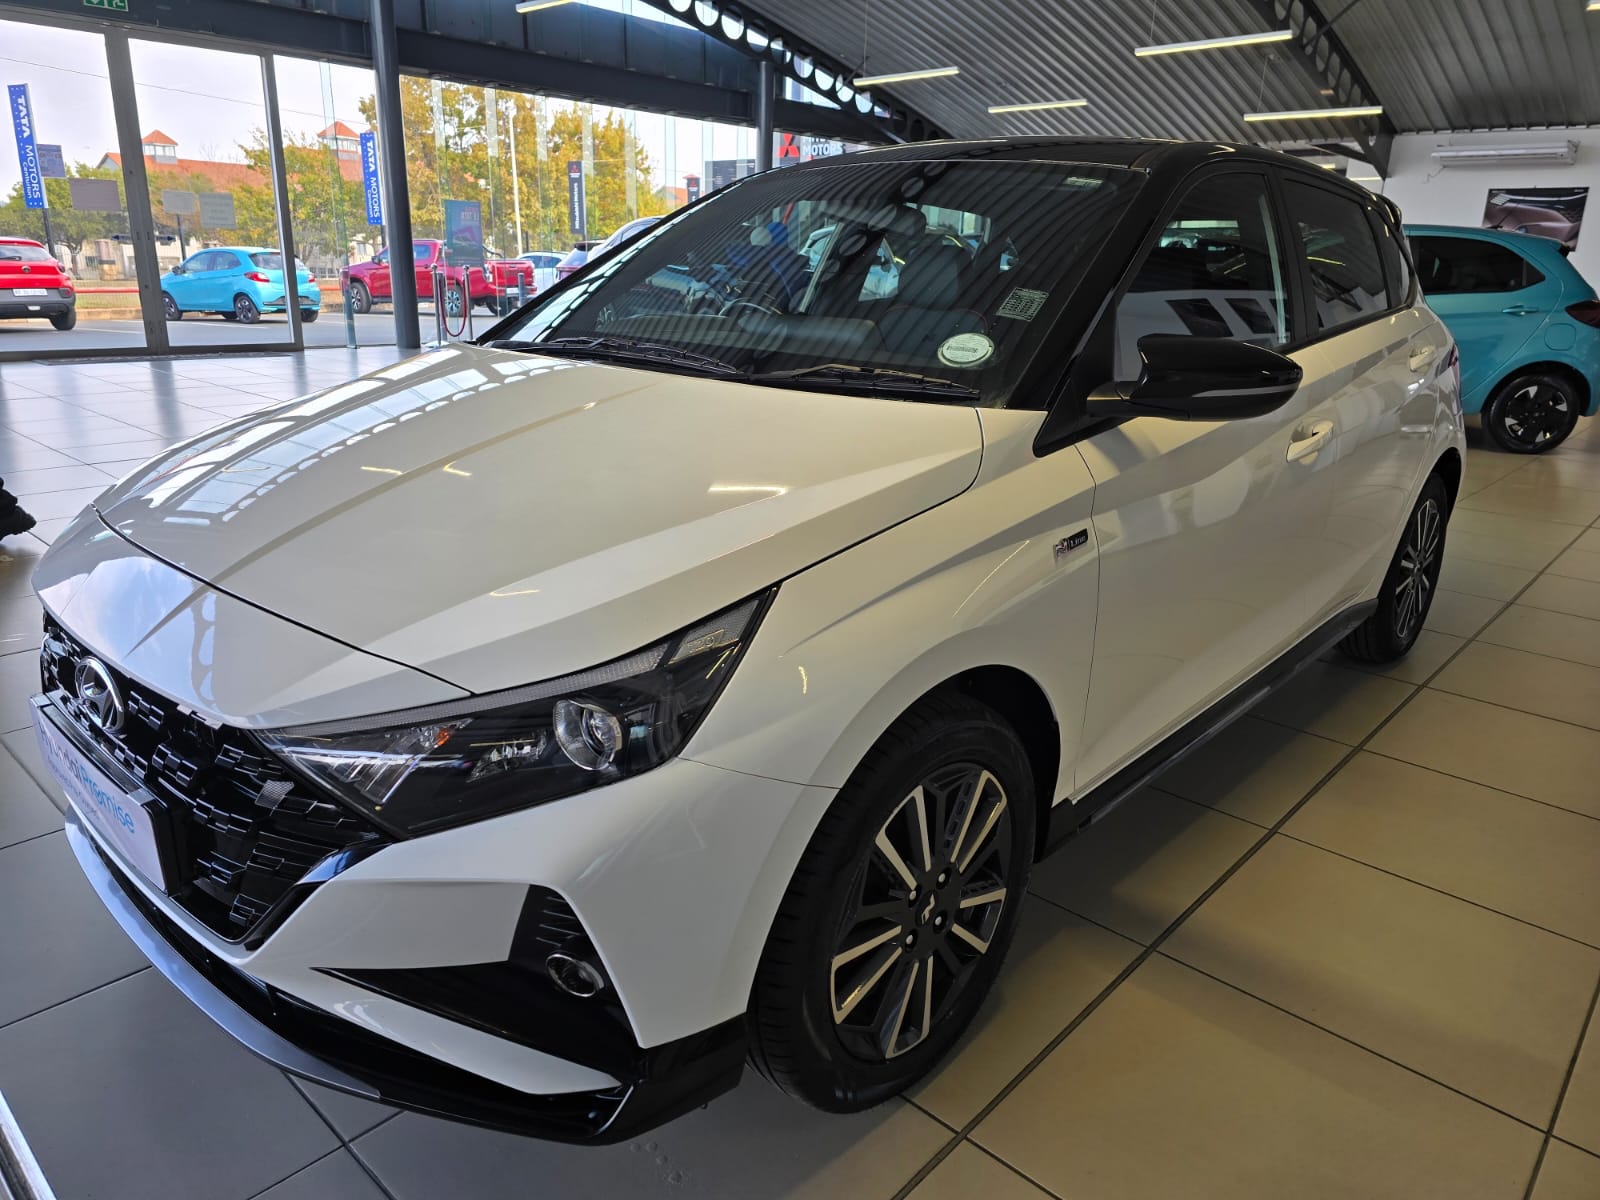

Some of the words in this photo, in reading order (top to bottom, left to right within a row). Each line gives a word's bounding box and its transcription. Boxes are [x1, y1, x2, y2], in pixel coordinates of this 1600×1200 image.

[17, 95, 30, 138] TATA
[25, 145, 41, 199] MOTORS
[366, 140, 376, 173] TATA
[803, 144, 844, 156] MOTORS
[22, 161, 33, 199] Centurion
[369, 176, 381, 218] MOTORS
